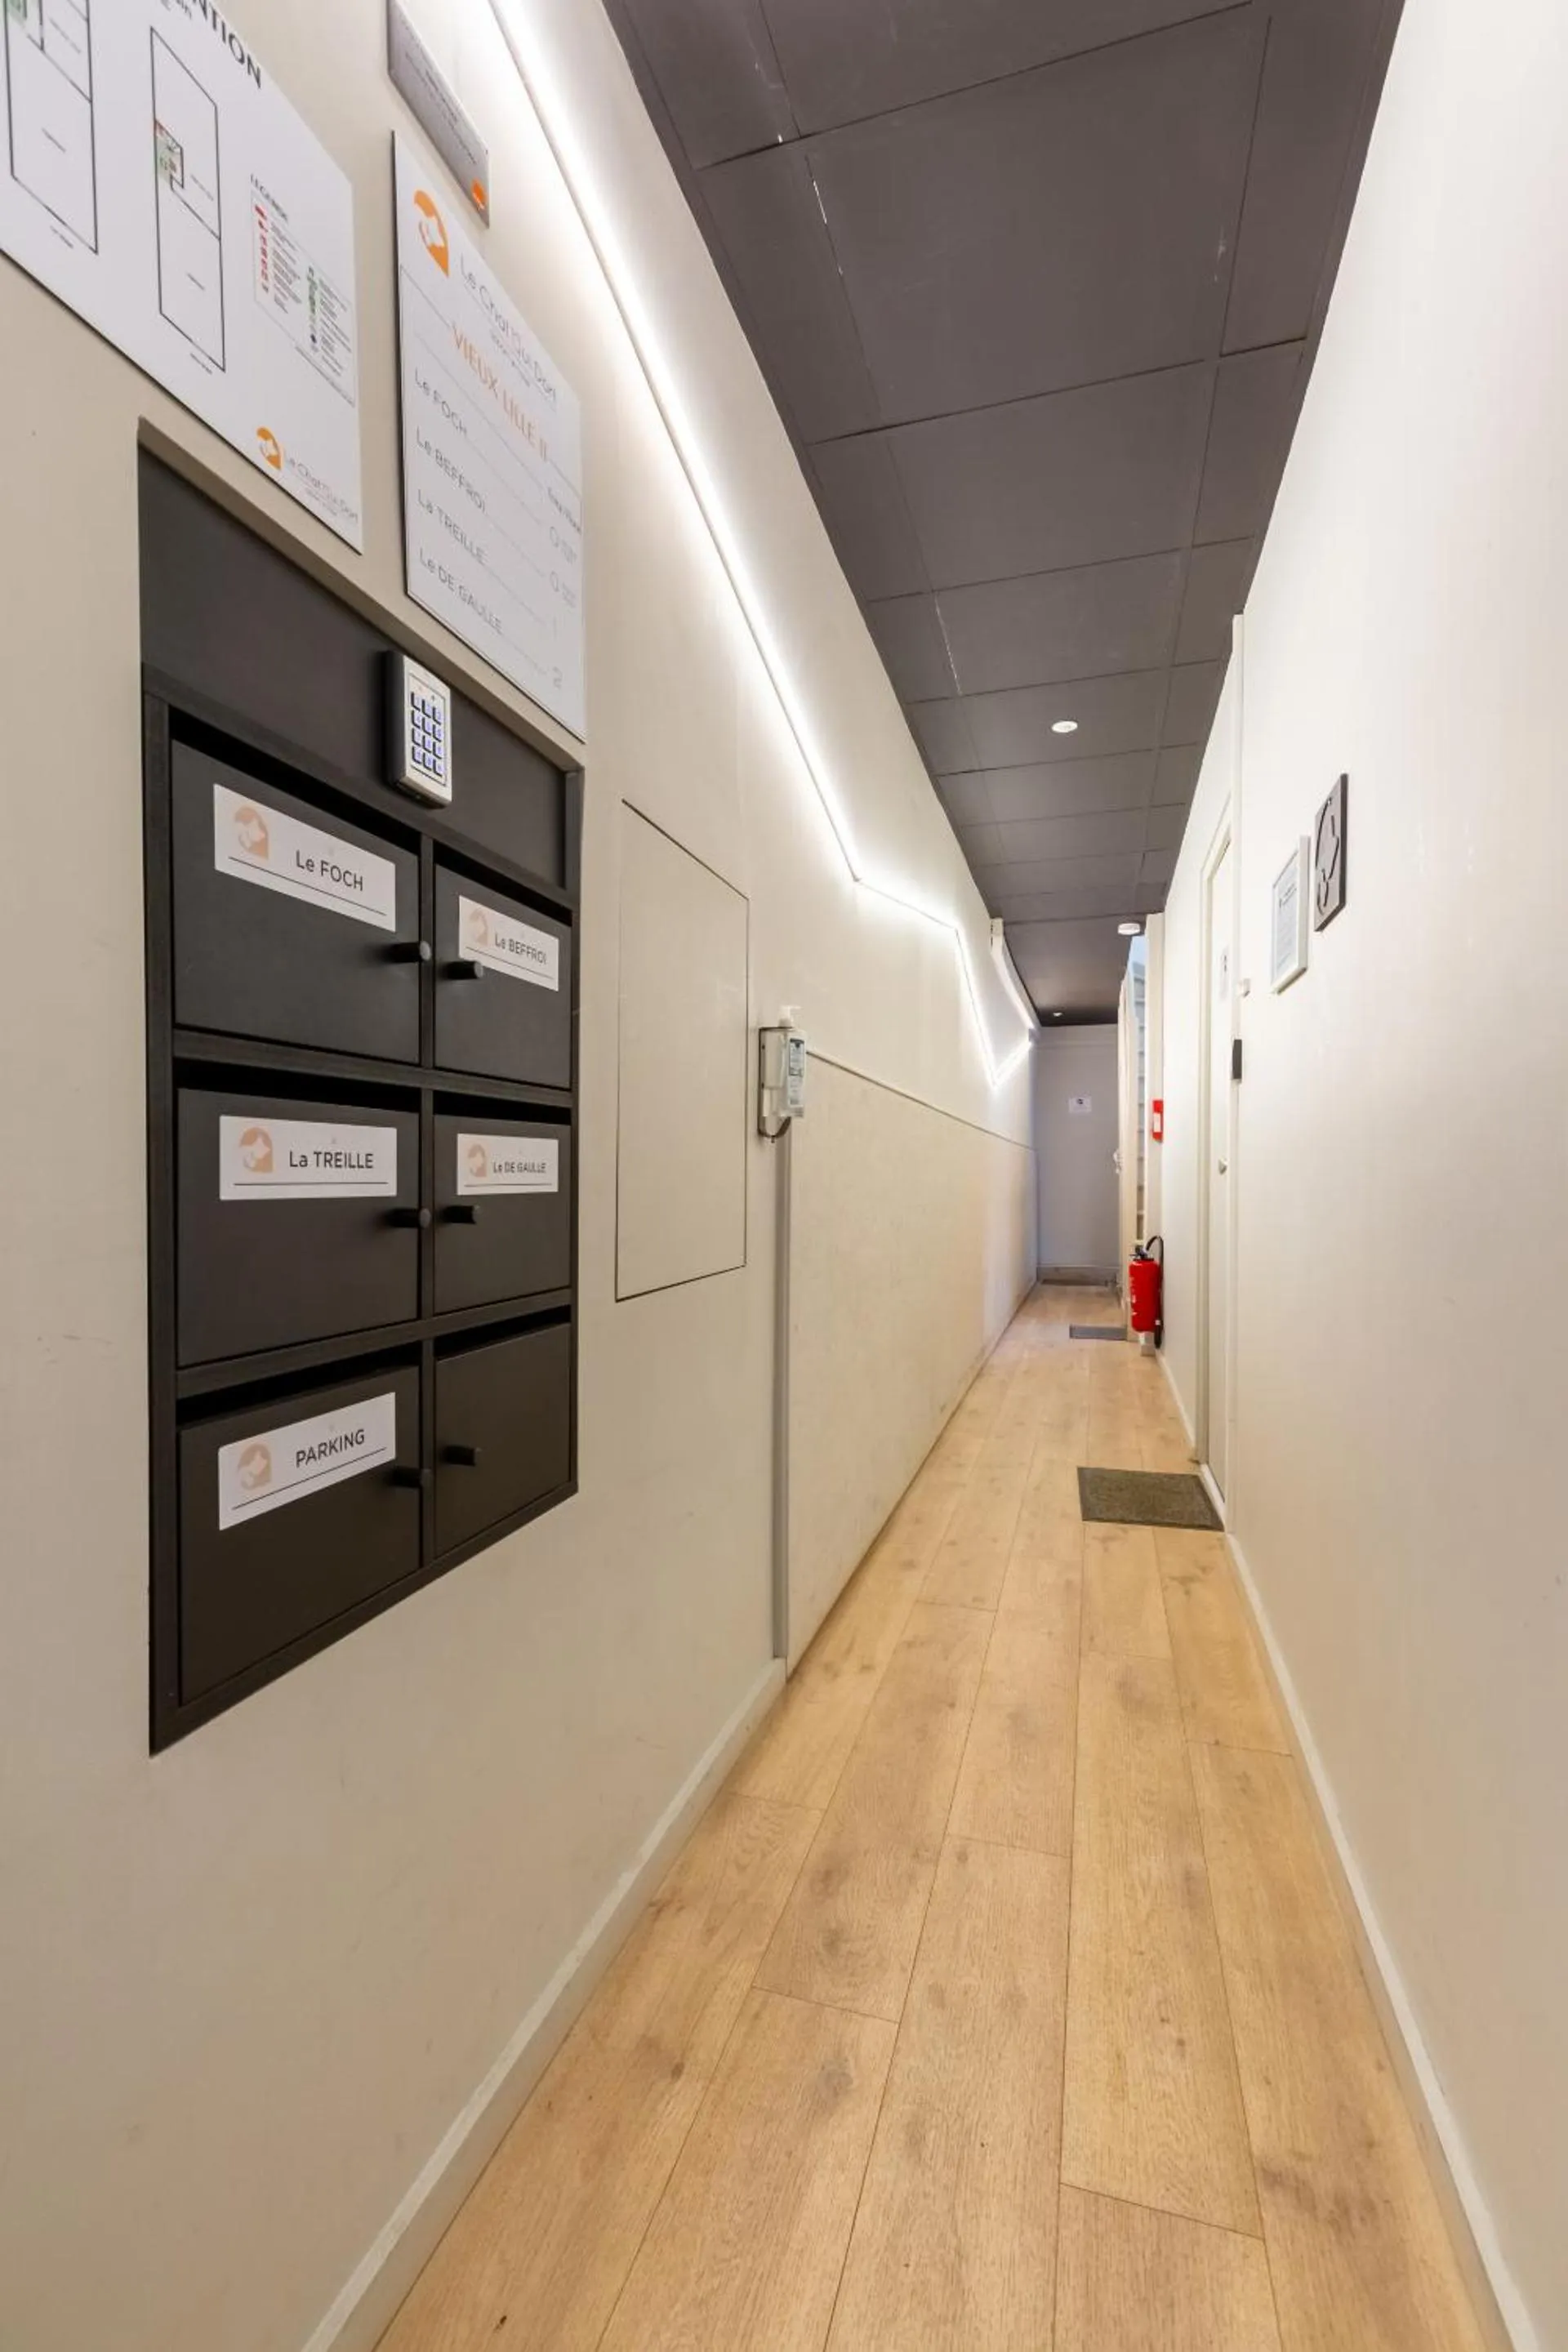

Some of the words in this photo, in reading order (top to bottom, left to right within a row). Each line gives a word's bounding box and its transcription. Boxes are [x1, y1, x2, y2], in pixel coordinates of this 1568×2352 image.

[416, 367, 430, 396] Le
[434, 390, 467, 438] FOCH
[453, 323, 497, 399] VIEUX
[503, 390, 535, 447] LILLE
[416, 425, 431, 456] Le
[435, 448, 485, 513] BEFFROI
[418, 489, 434, 514] La
[437, 506, 486, 565] TREILLE
[420, 547, 435, 573] Le
[439, 565, 455, 591] DE
[459, 585, 502, 635] GAULLE
[296, 849, 315, 873] Le
[321, 859, 363, 892] FOCH
[495, 932, 506, 950] Le
[509, 938, 546, 965] BEFFROI
[290, 1150, 308, 1168] La
[314, 1151, 373, 1169] TREILLE
[493, 1161, 502, 1174] Le
[504, 1161, 515, 1174] DE
[517, 1161, 546, 1174] GAULLE
[296, 1428, 364, 1468] PARKING
